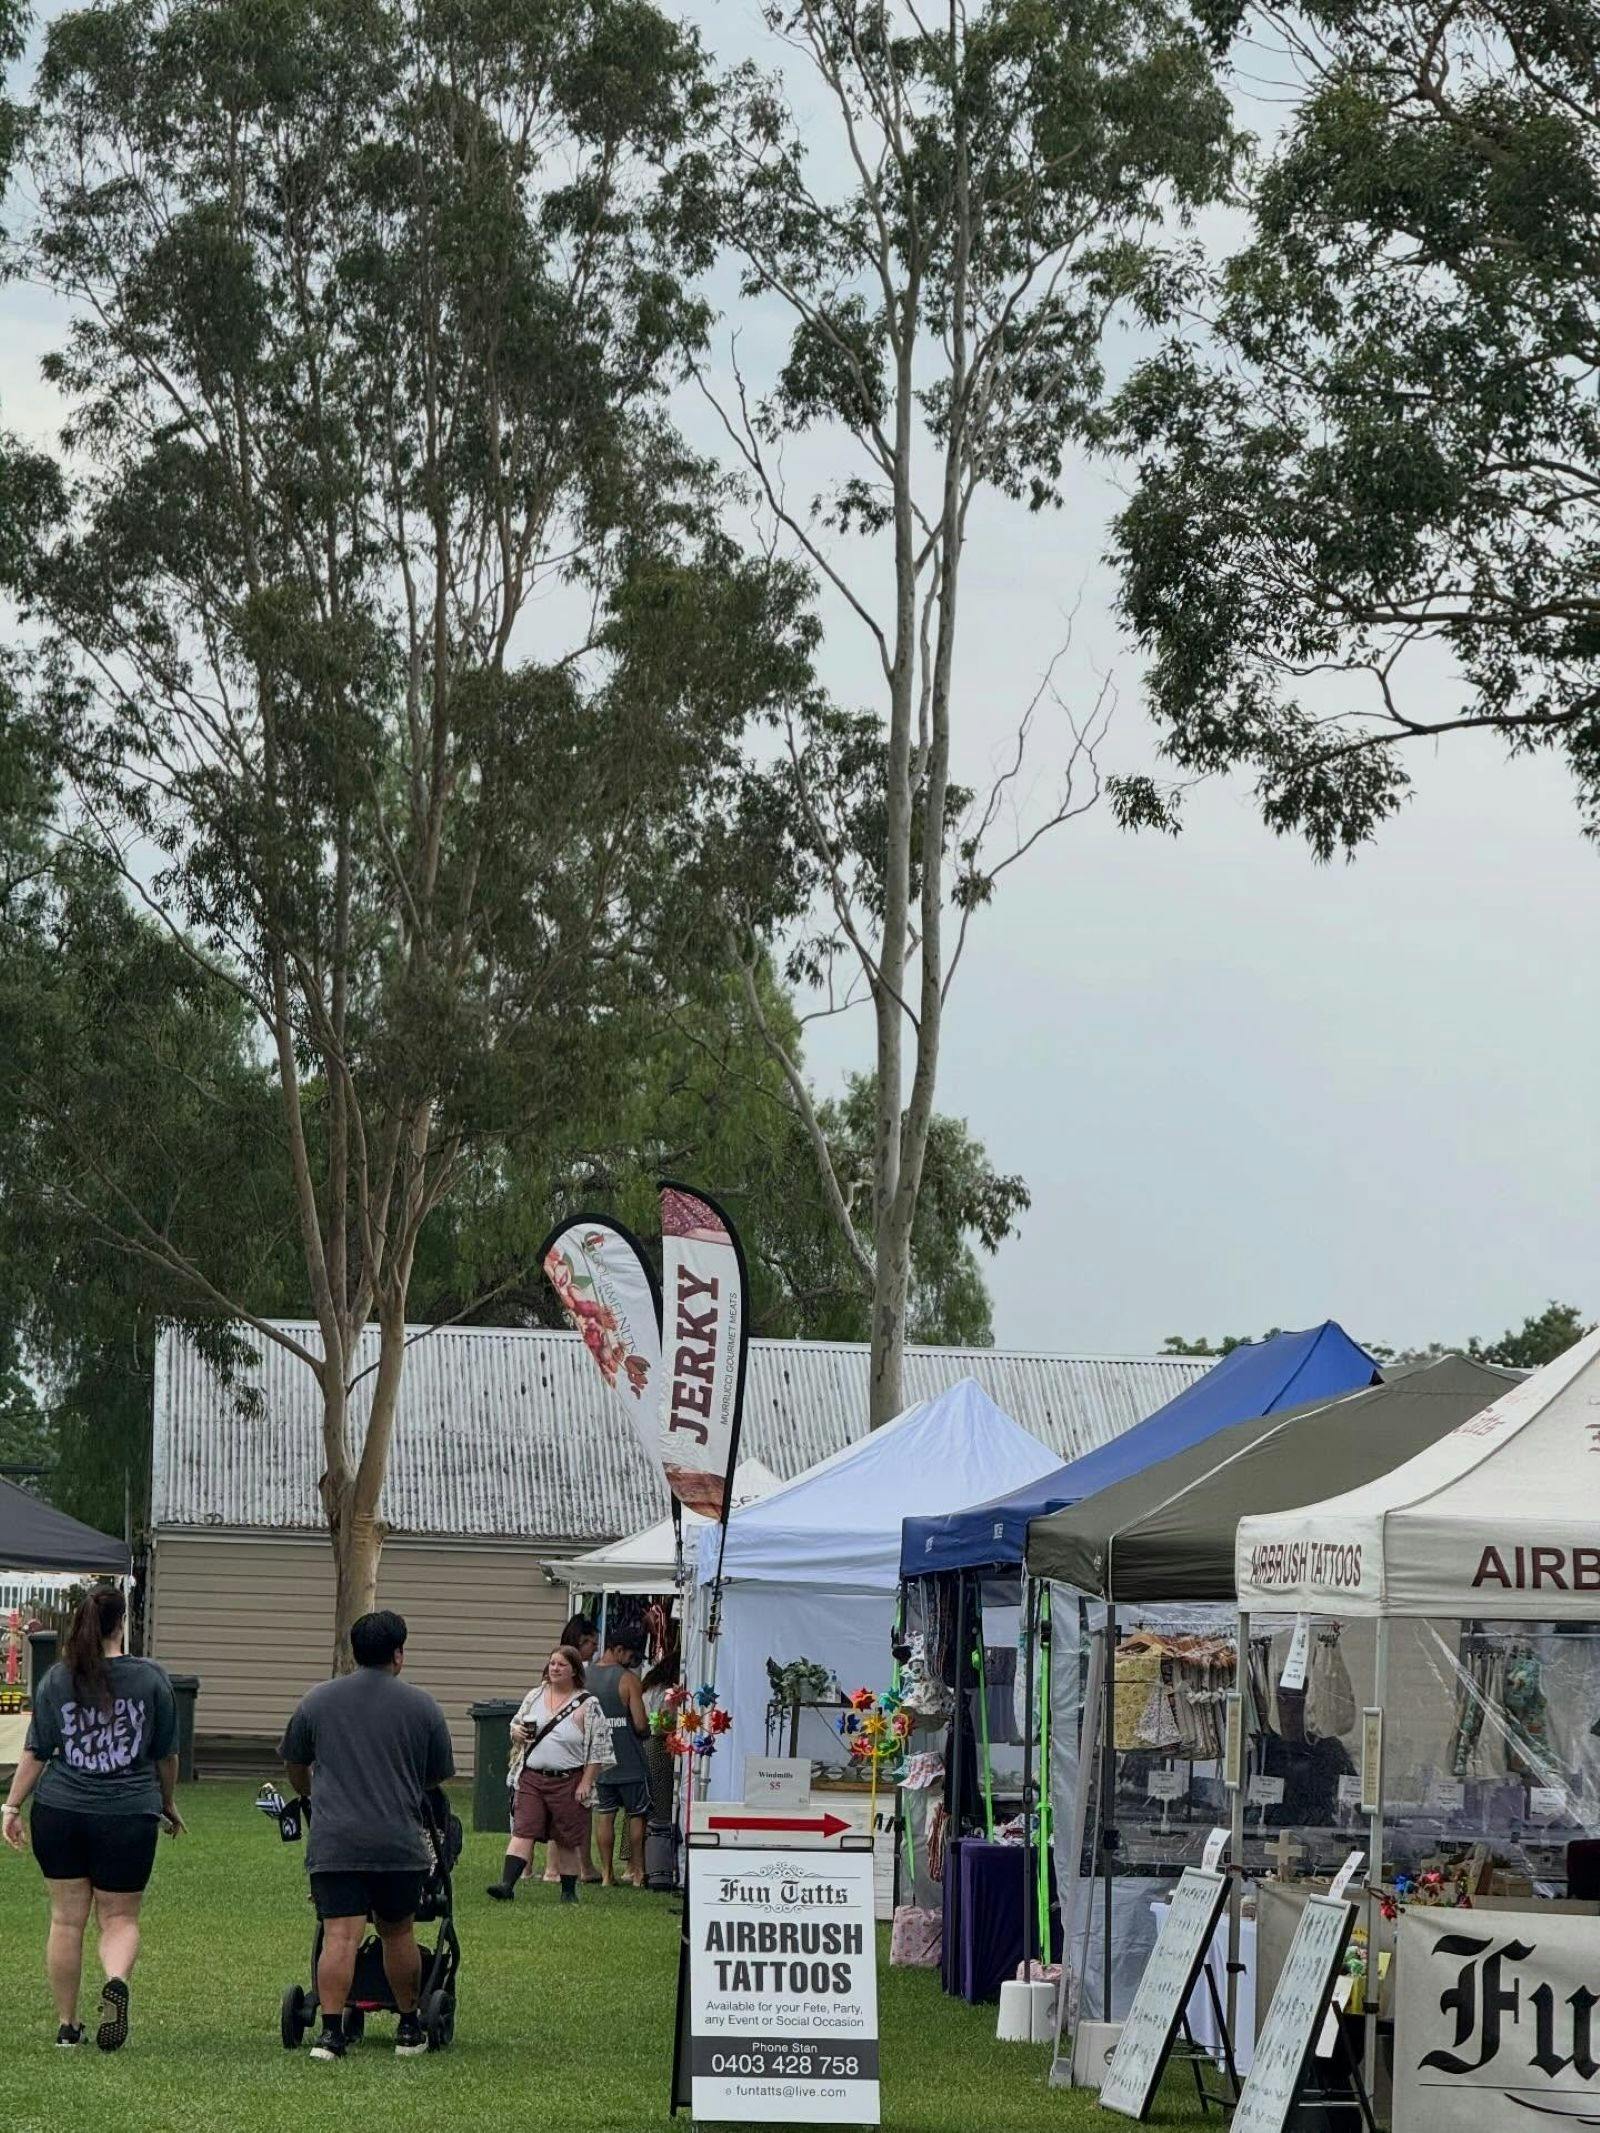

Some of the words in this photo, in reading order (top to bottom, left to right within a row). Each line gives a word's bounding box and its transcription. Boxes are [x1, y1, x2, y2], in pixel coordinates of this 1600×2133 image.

[730, 1292, 738, 1326] MEATS
[669, 1264, 719, 1446] JERKY
[727, 1327, 736, 1373] GOURMET
[1251, 1541, 1309, 1584] AIRBRUSH
[1311, 1542, 1362, 1586] TATTOOS
[81, 1716, 128, 1753] THE
[769, 1782, 781, 1791] $5
[718, 1878, 771, 1903] Fun
[780, 1880, 849, 1904] Tatts
[705, 1921, 863, 1955] AIRBRUSH
[714, 1960, 852, 1994] TATTOOS
[704, 2016, 724, 2027] any
[728, 2015, 759, 2025] Event
[761, 2017, 773, 2026] or
[775, 2015, 810, 2026] Social
[812, 2016, 864, 2027] Occasion
[705, 2001, 755, 2012] Available
[758, 2002, 772, 2012] for
[775, 2003, 801, 2016] your
[833, 2003, 863, 2015] Party,
[1417, 1934, 1600, 2081] Fu
[711, 2053, 765, 2074] 0403
[771, 2055, 812, 2075] 428
[819, 2056, 859, 2075] 758
[752, 2042, 789, 2053] Phone
[792, 2043, 818, 2053] Stan
[736, 2085, 846, 2098] funtatts@live.com
